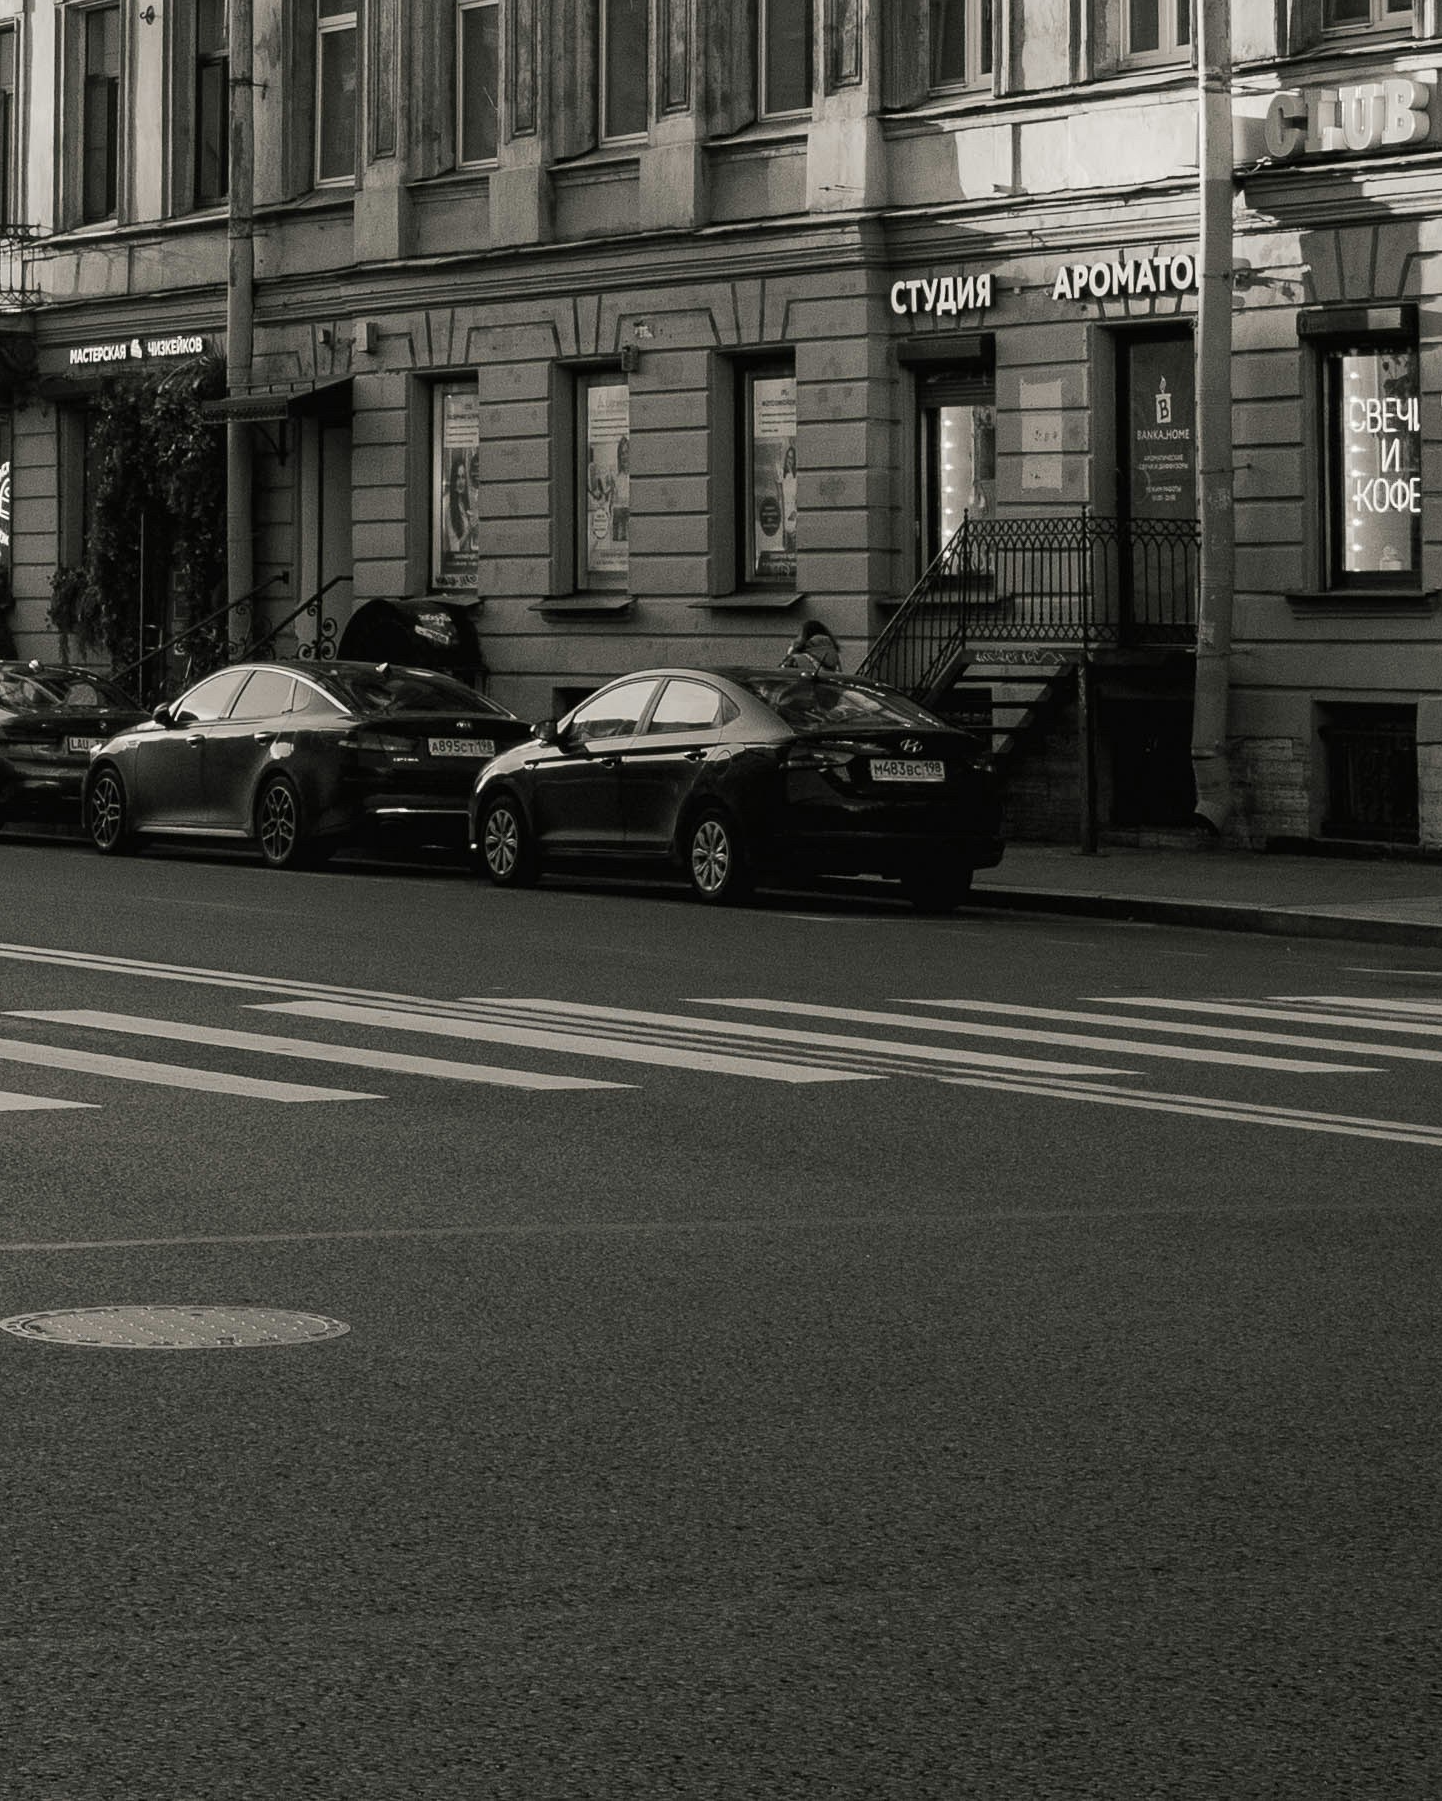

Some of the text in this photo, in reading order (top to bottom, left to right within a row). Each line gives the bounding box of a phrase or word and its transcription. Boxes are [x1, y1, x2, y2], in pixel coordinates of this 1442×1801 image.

[1265, 79, 1430, 157] CLUB
[891, 272, 994, 316] СТУДИЯ
[70, 336, 203, 364] МАСТЕРСКАЯ ЧИЗКЕЙКОВ
[1381, 438, 1400, 472] И
[1357, 478, 1421, 513] КОФЕ
